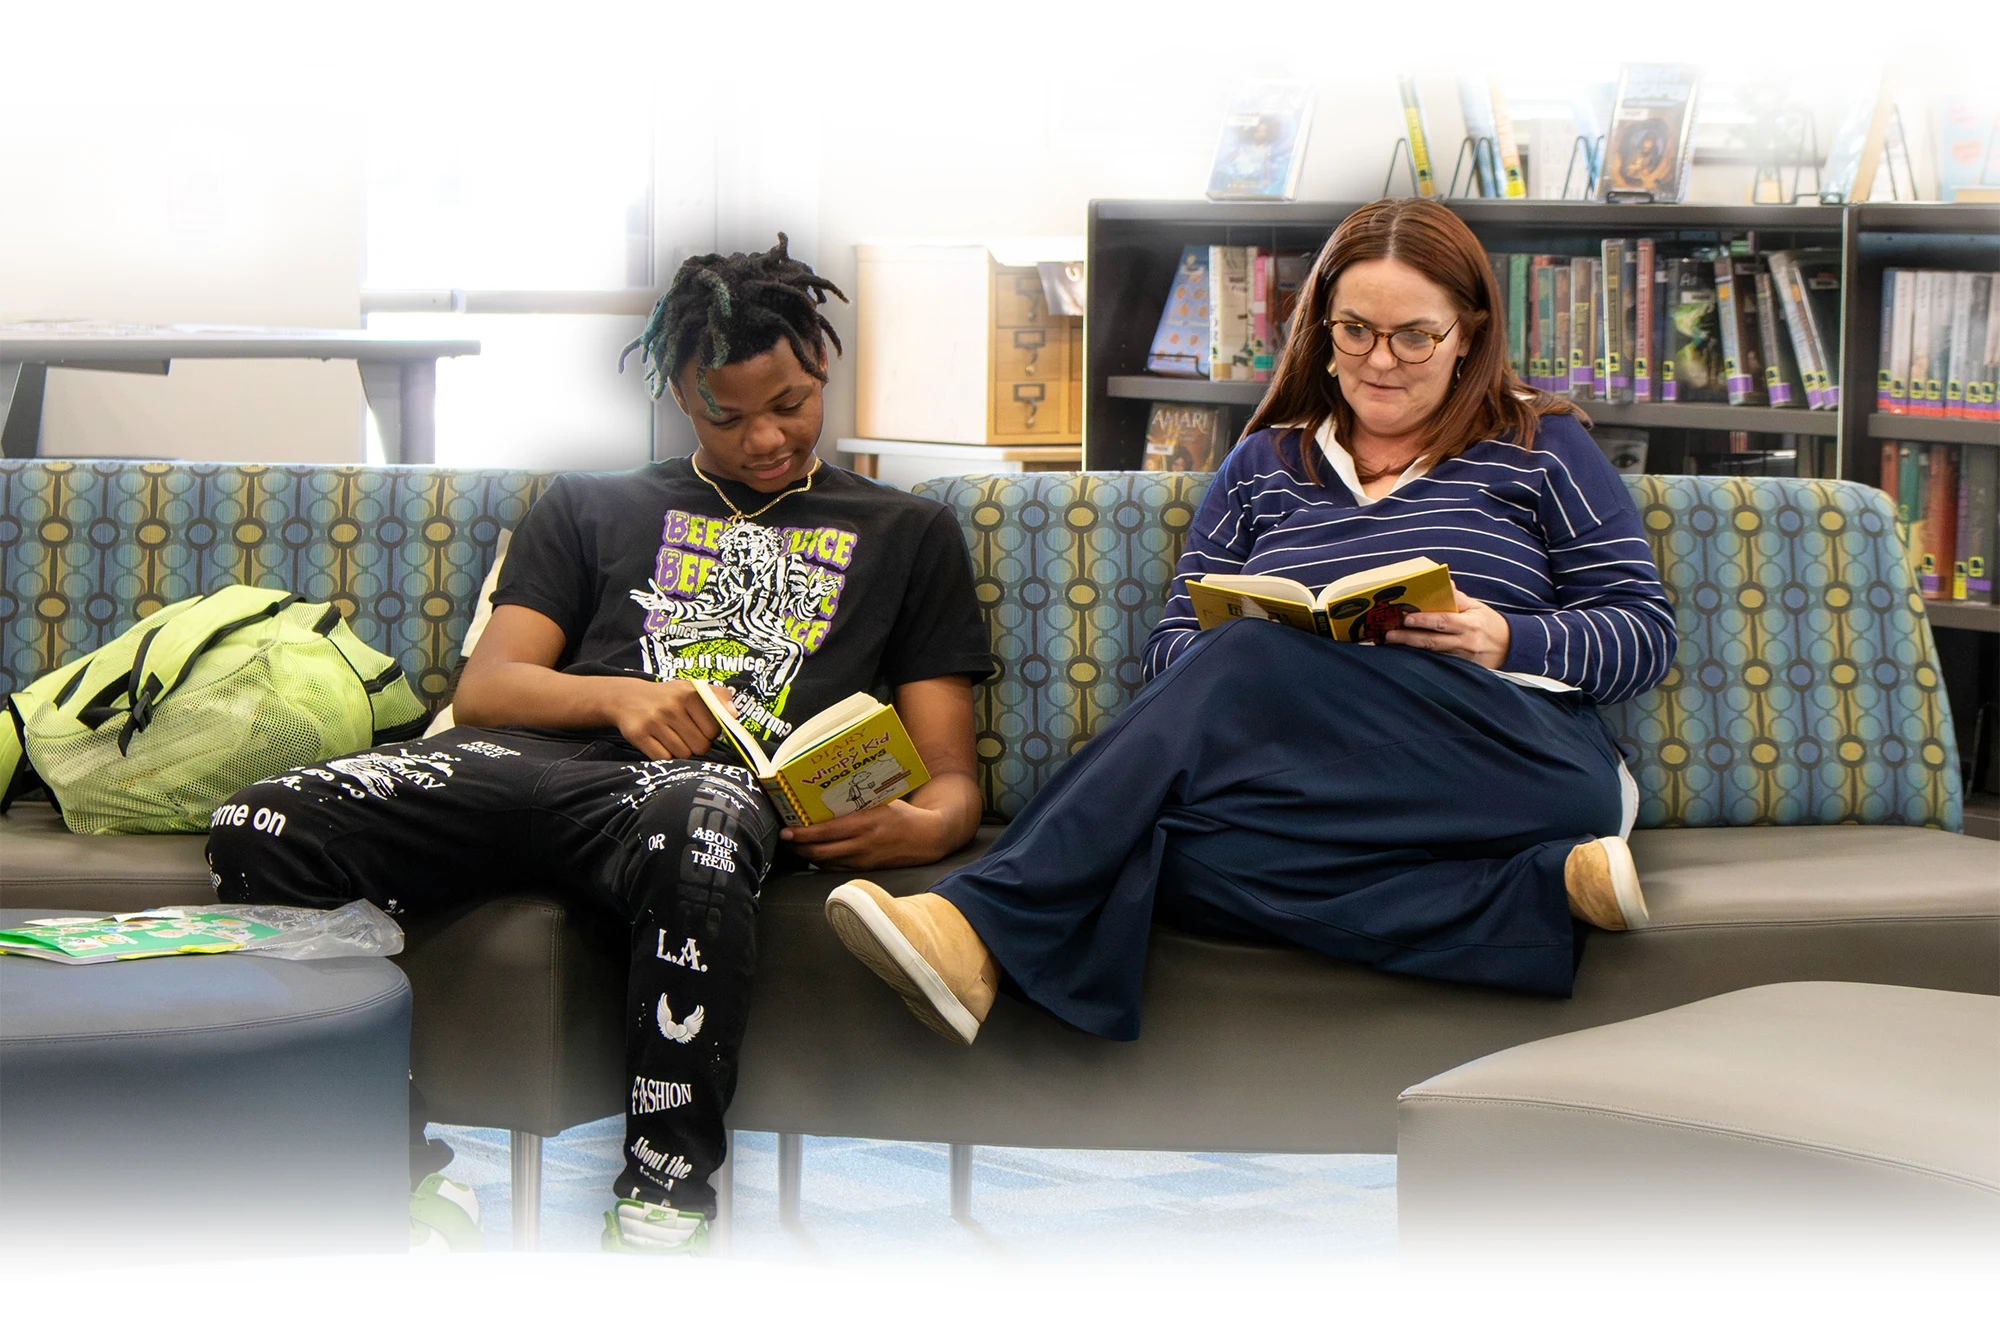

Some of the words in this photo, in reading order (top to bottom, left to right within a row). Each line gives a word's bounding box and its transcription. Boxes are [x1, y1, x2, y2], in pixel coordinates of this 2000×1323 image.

[1151, 410, 1209, 434] AMARI
[698, 653, 712, 669] it
[810, 727, 867, 765] DIARY
[861, 731, 891, 754] Kid
[819, 769, 851, 789] DOG
[253, 807, 286, 837] on
[648, 833, 666, 851] OR
[692, 827, 739, 852] ABOUT
[705, 842, 733, 861] THE
[691, 850, 736, 874] TREND
[656, 928, 708, 973] L.A.
[631, 1075, 692, 1115] FASHION
[630, 1136, 669, 1171] About
[664, 1155, 693, 1180] the
